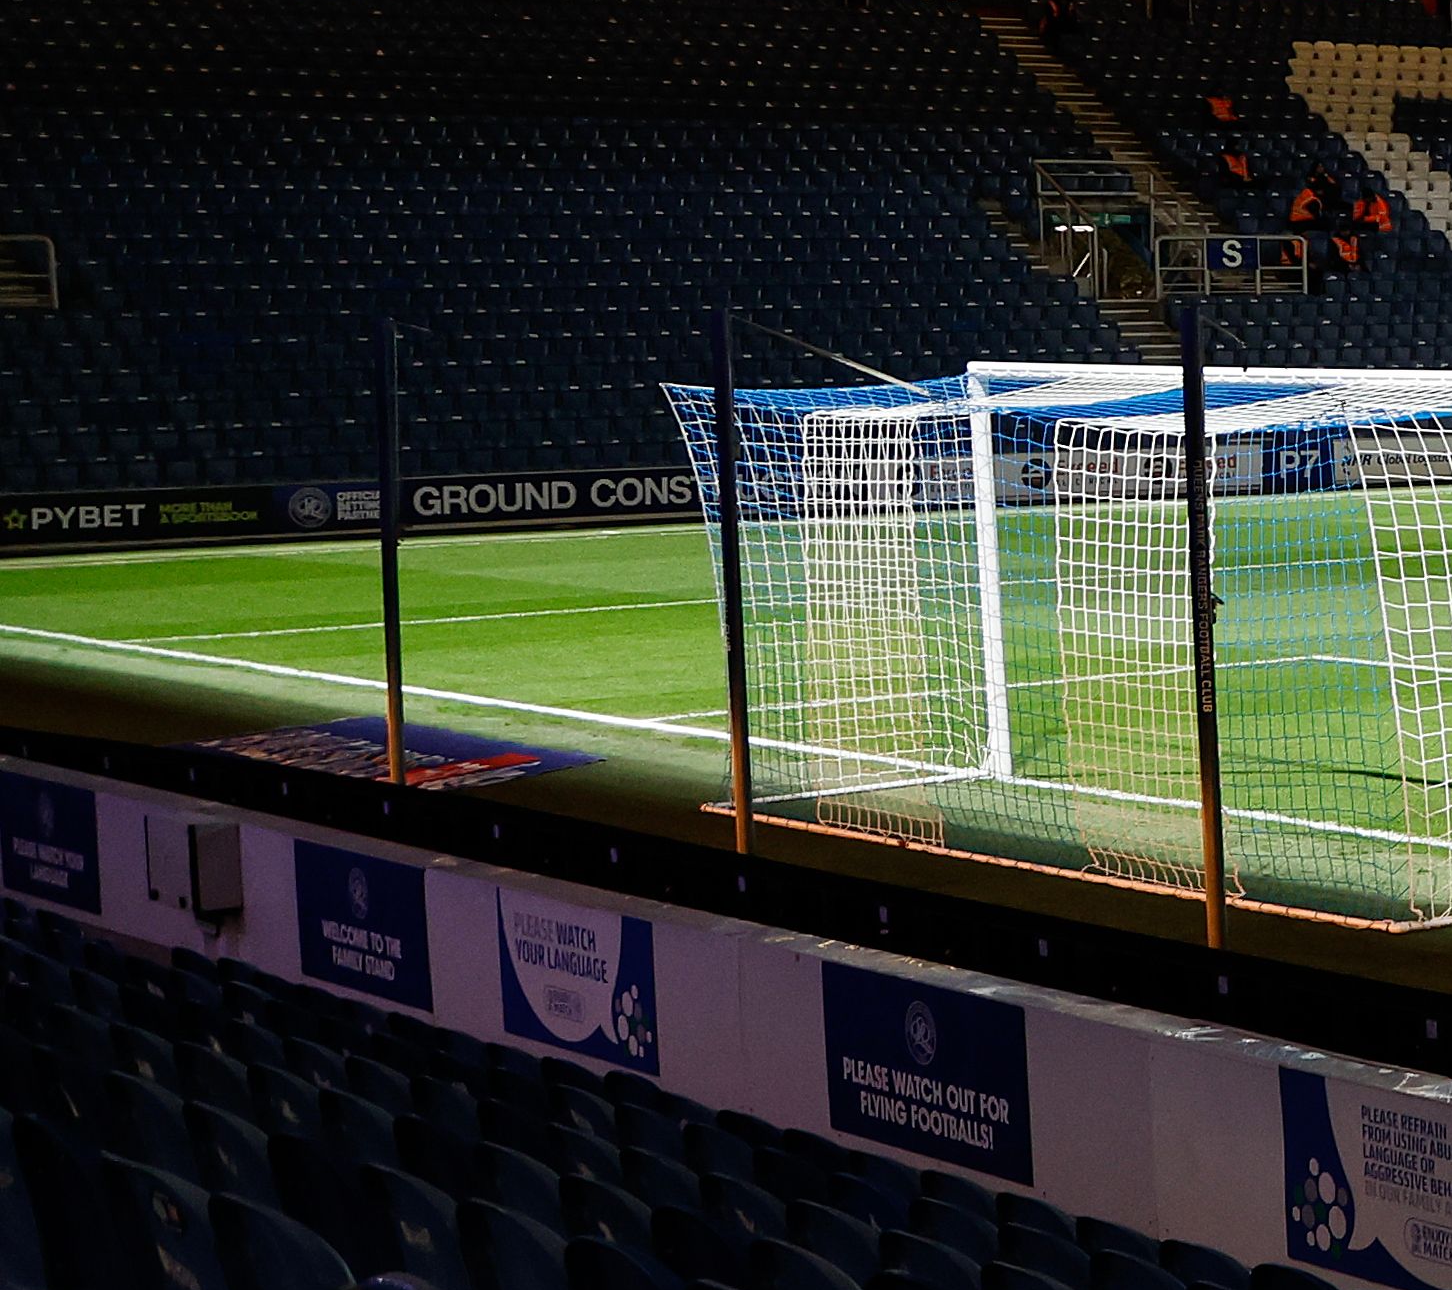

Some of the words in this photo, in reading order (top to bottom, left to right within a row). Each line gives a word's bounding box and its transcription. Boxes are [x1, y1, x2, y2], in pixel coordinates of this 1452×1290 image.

[1222, 240, 1242, 268] S
[1279, 450, 1319, 479] P7
[413, 481, 576, 516] GROUND
[1201, 680, 1213, 713] CLUB
[372, 930, 384, 952] TO
[513, 912, 553, 943] PLEASE
[556, 920, 596, 952] WATCH
[515, 938, 544, 967] YOUR
[547, 945, 608, 984] LANGUAGE
[842, 1056, 889, 1092] PLEASE
[891, 1069, 943, 1107] WATCH
[946, 1085, 976, 1115] OUT
[980, 1093, 1010, 1125] FOR
[860, 1090, 907, 1125] FLYING
[910, 1104, 994, 1151] FOOTBALLS!
[1361, 1105, 1399, 1129] PLEASE
[1401, 1114, 1447, 1140] REFRAIN
[1362, 1124, 1391, 1146] FROM
[1394, 1132, 1426, 1155] USING
[1363, 1143, 1417, 1172] LANGUAGE
[1420, 1158, 1435, 1174] OR
[1364, 1161, 1427, 1192] AGGRESSIVE
